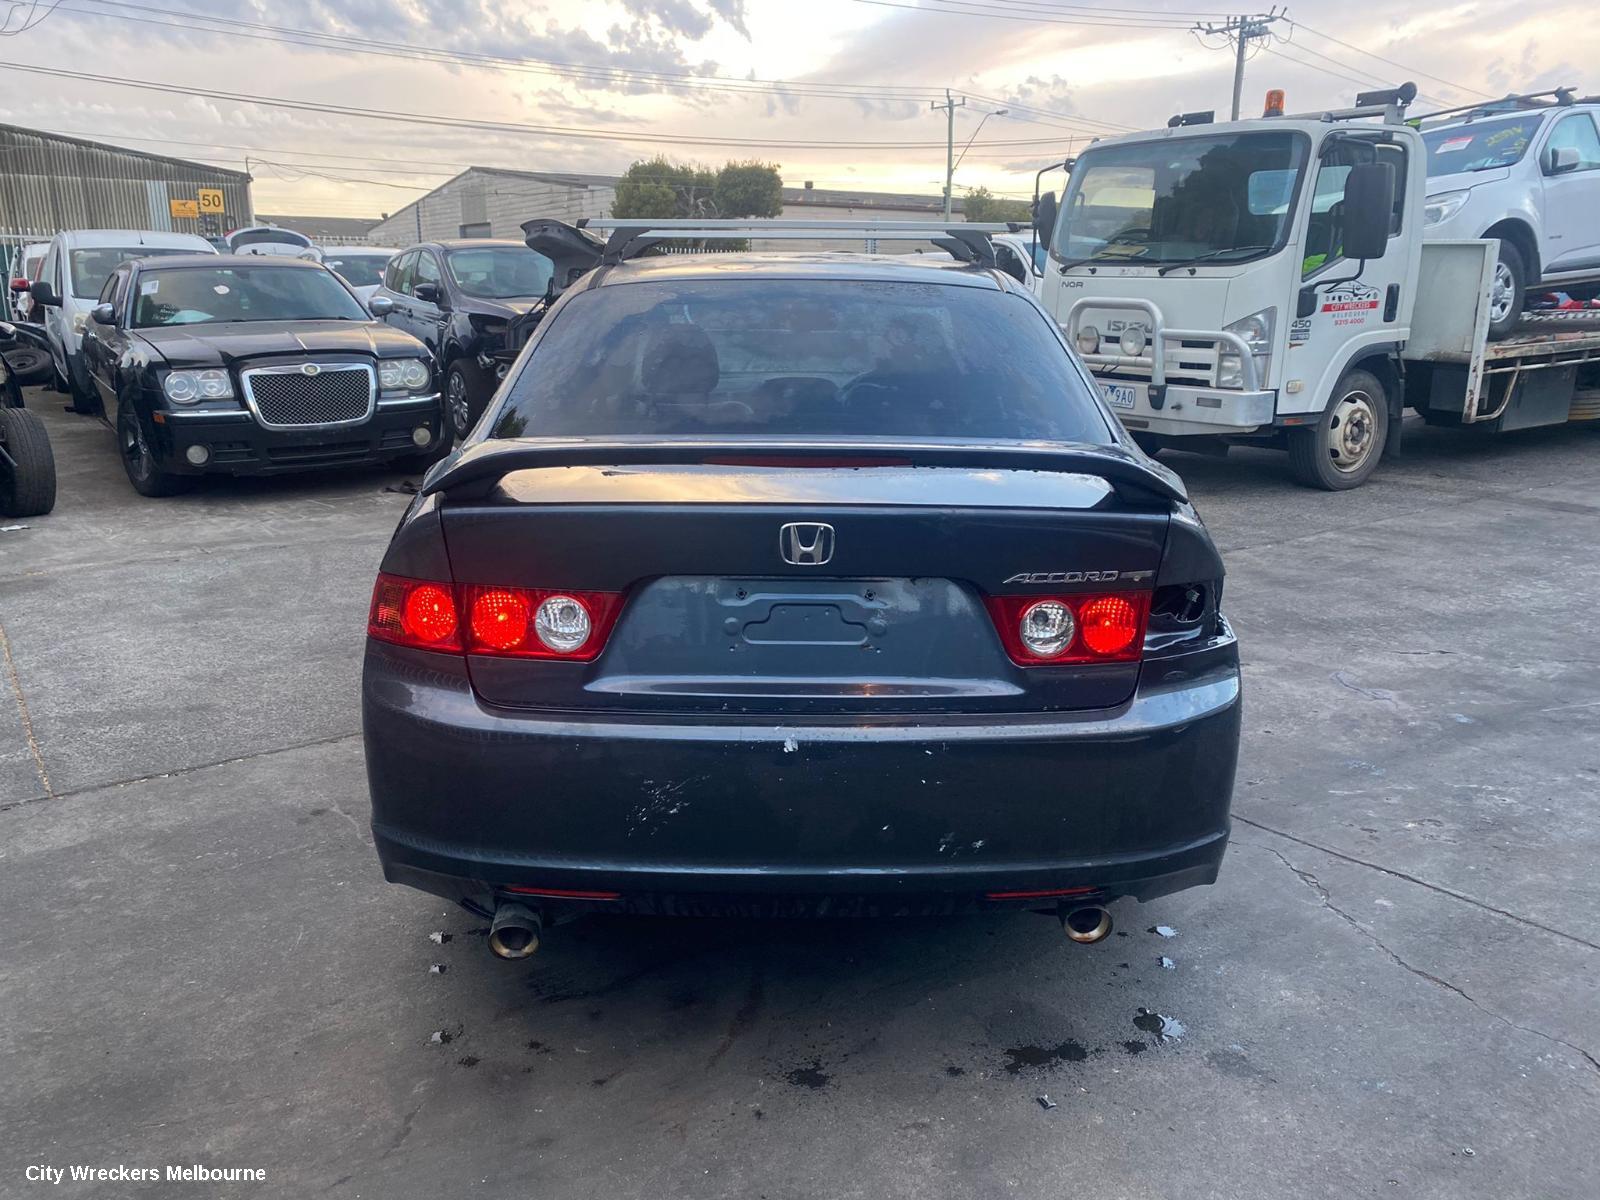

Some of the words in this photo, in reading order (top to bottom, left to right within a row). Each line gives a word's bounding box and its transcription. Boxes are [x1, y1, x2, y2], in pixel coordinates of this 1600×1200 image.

[202, 194, 221, 208] 50
[1331, 303, 1343, 311] CITY
[1291, 320, 1312, 328] 450
[1002, 570, 1119, 584] ACCORD
